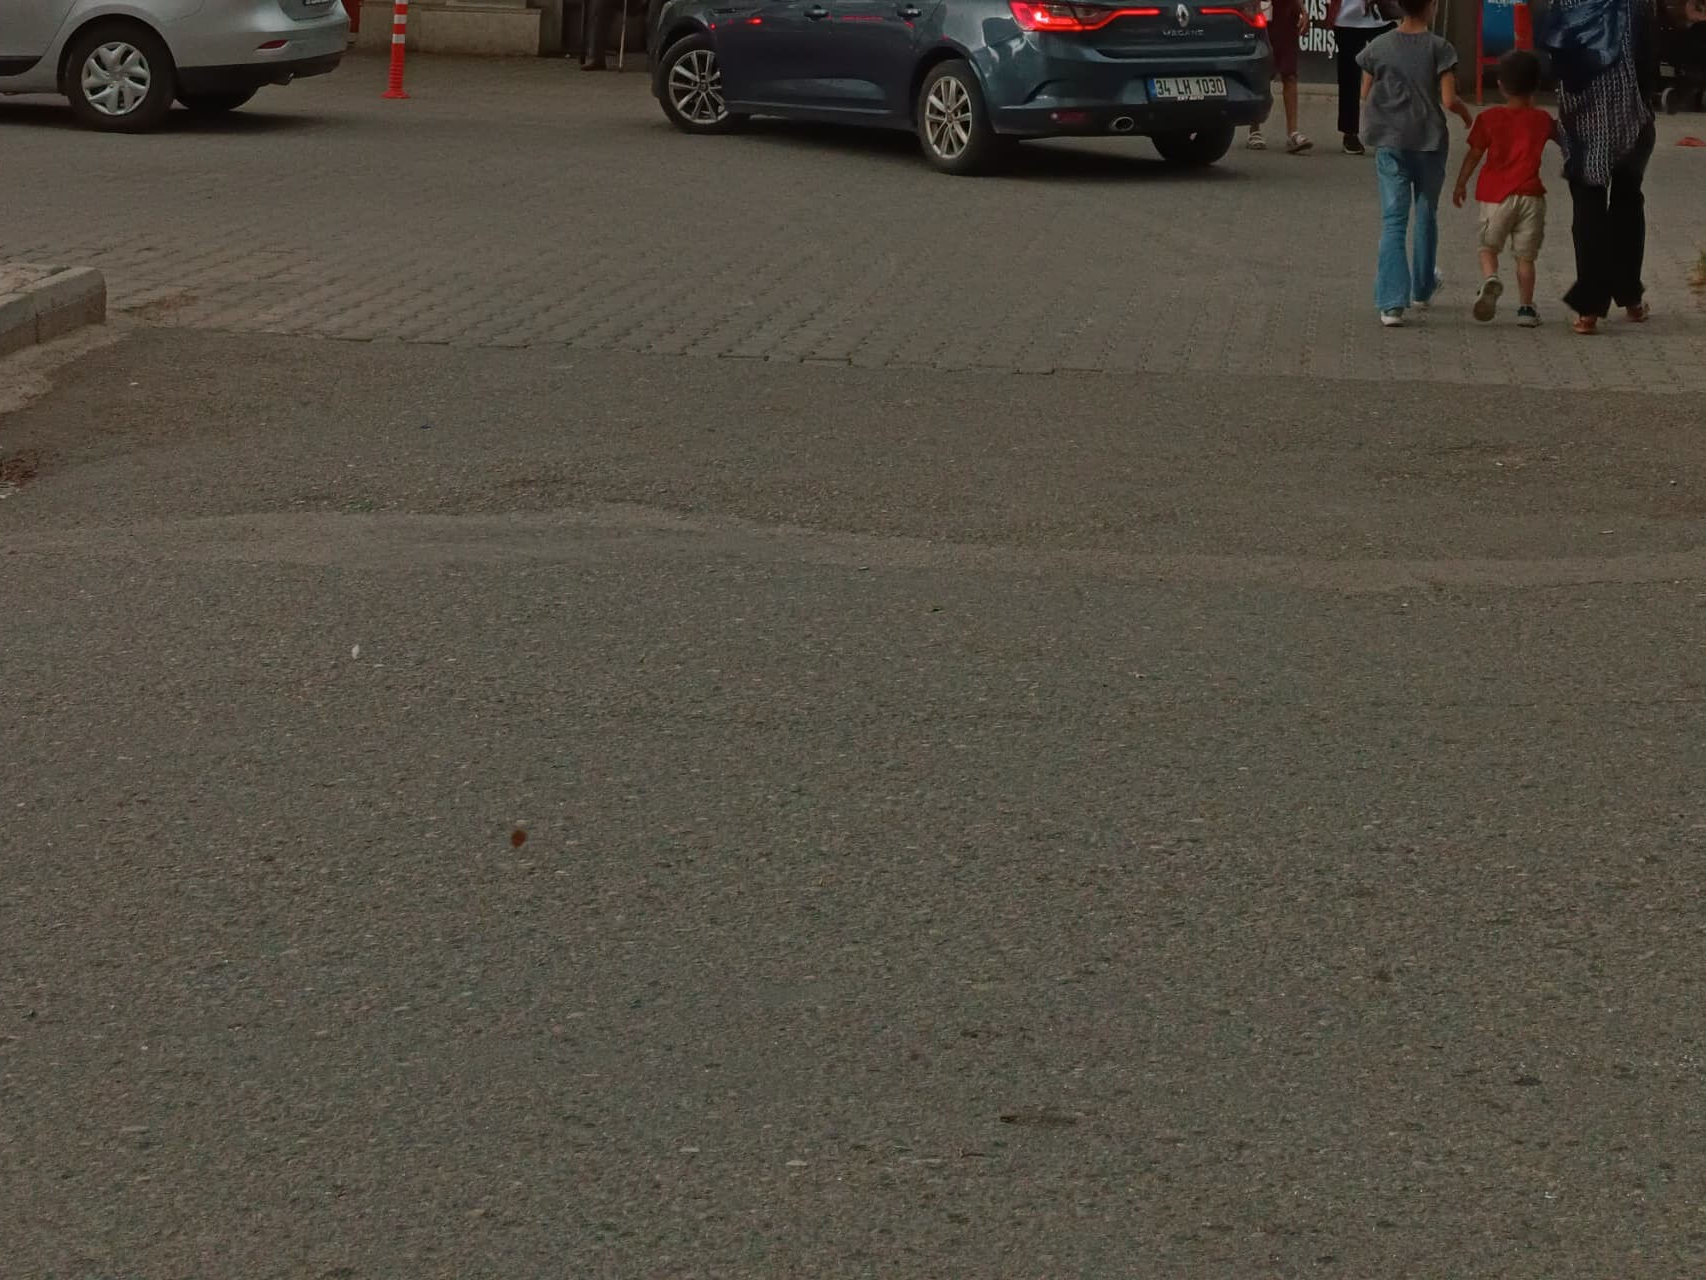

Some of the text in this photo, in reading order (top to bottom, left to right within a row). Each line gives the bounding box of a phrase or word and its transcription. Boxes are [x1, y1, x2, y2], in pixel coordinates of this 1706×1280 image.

[1155, 77, 1225, 96] 34 LH 1030
